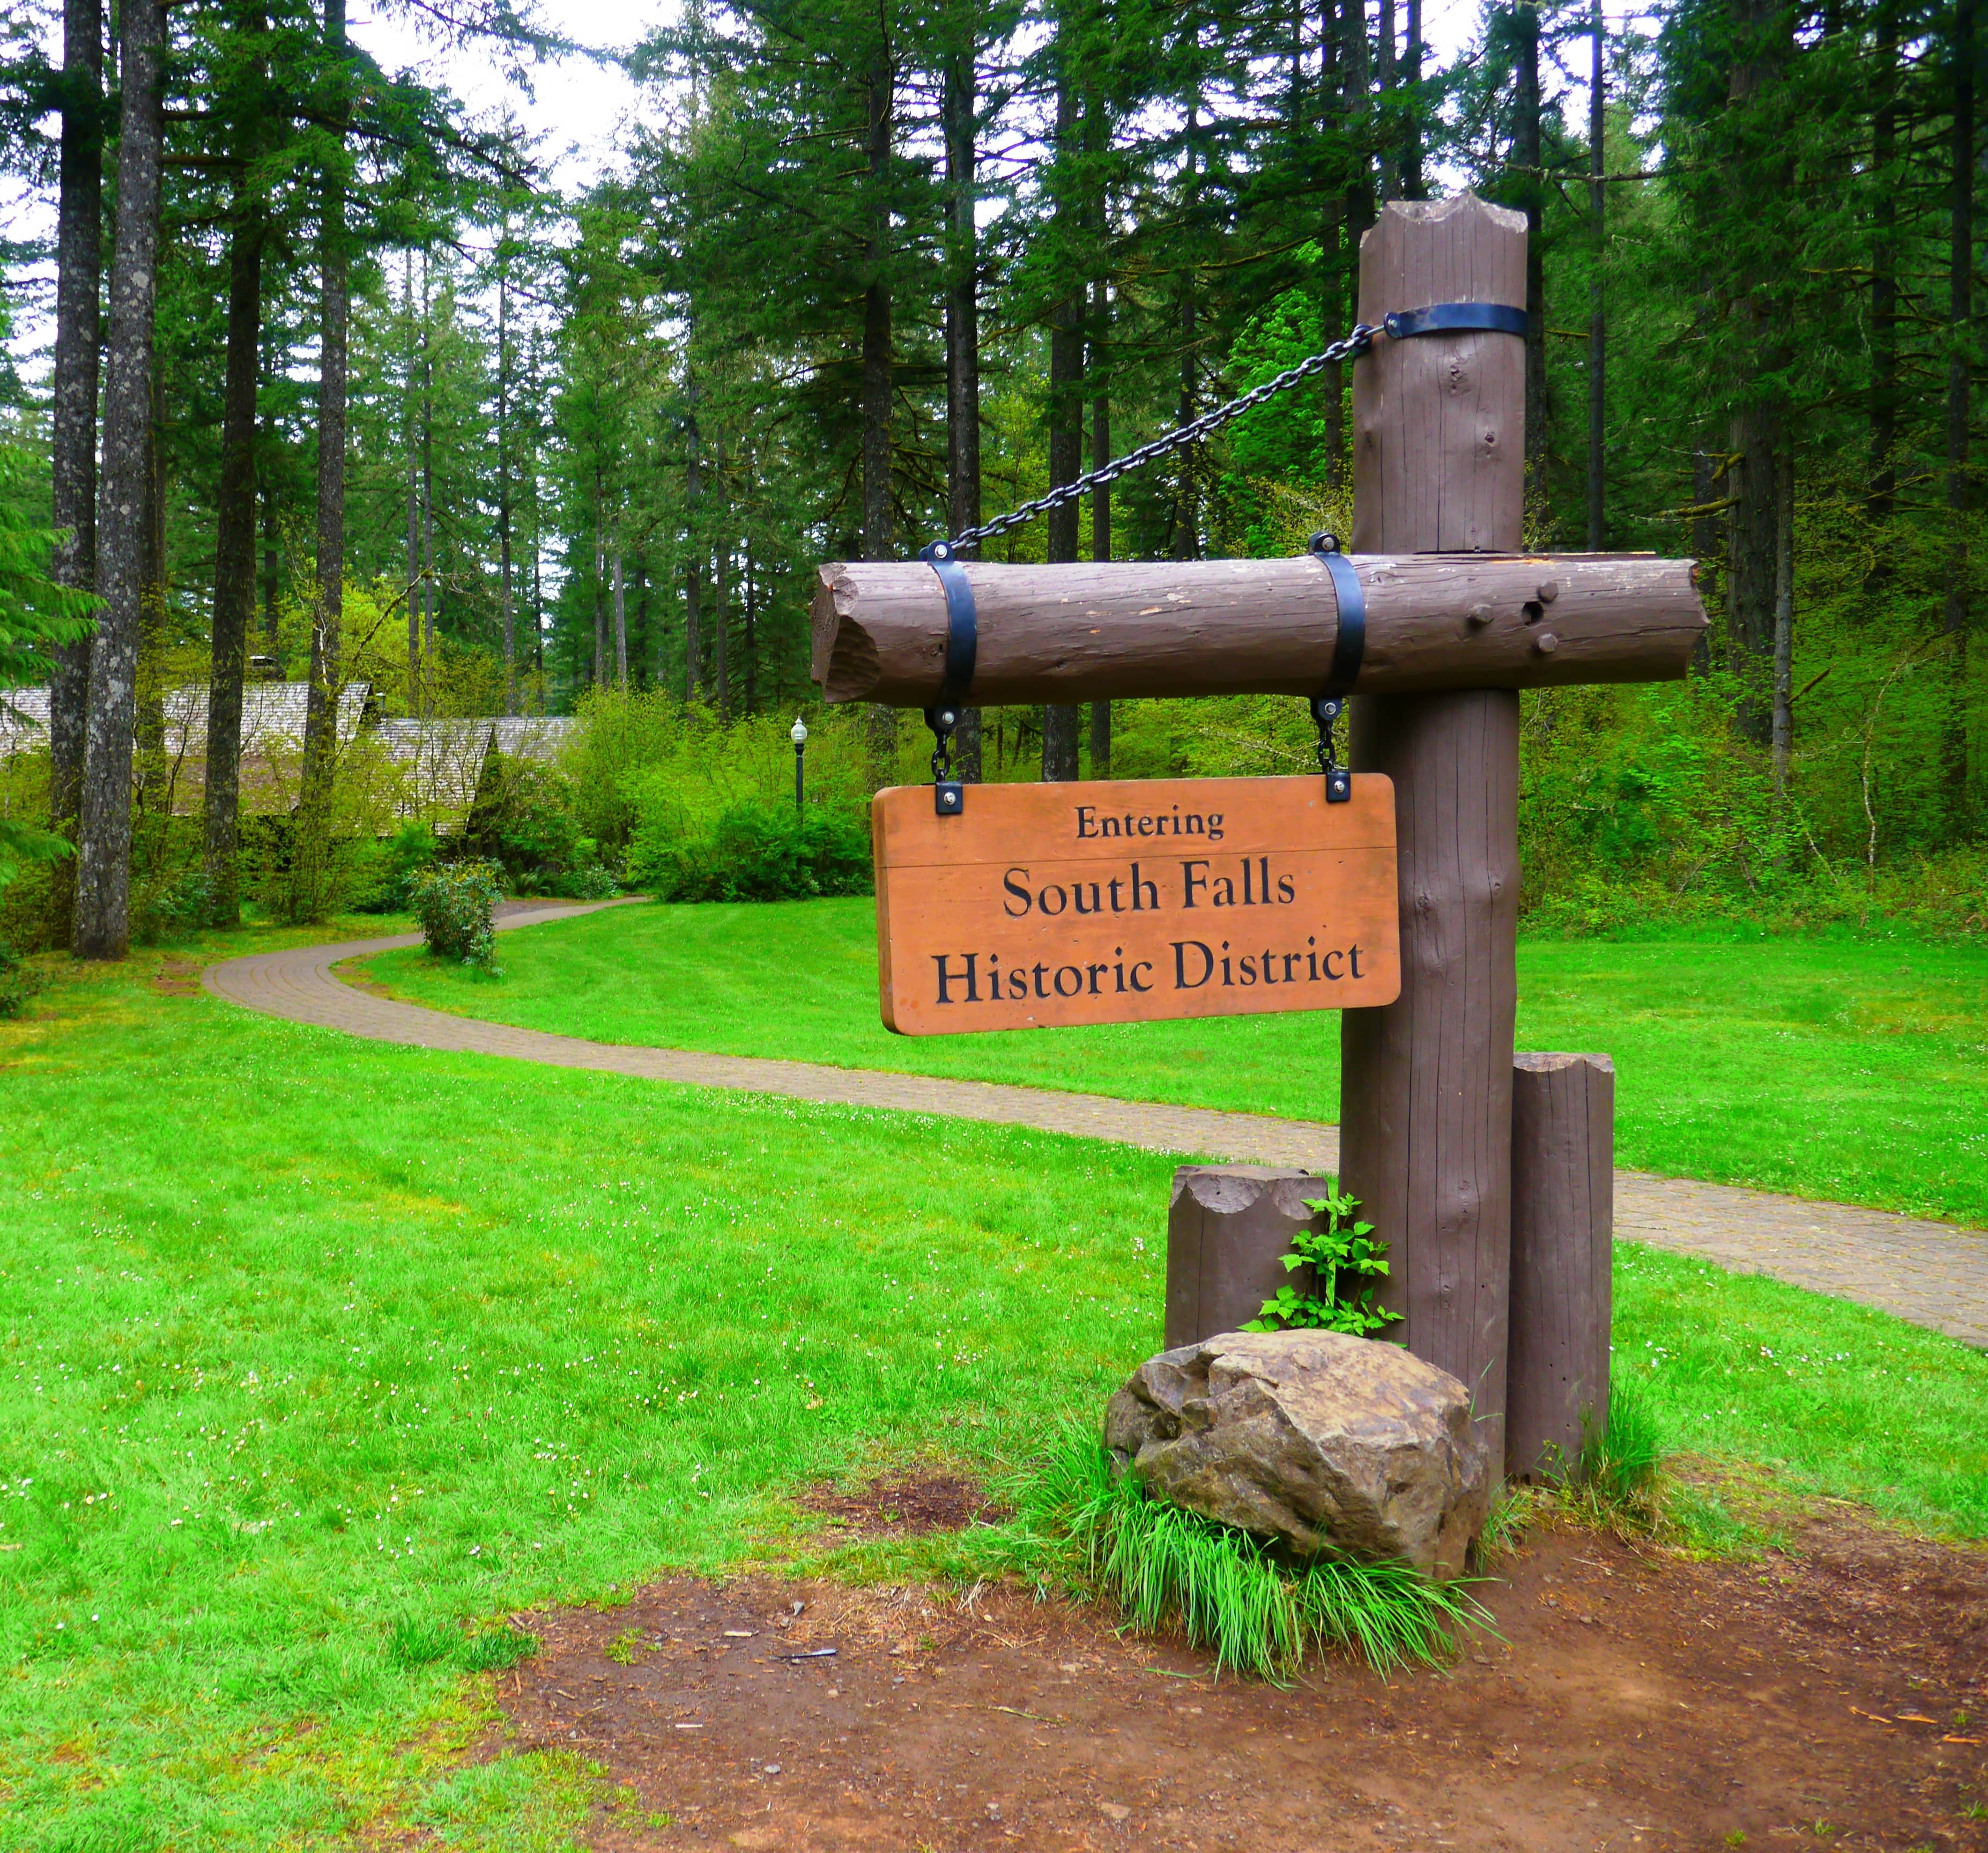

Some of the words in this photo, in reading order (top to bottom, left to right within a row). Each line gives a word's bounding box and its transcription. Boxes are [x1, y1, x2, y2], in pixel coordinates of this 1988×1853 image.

[1075, 805, 1225, 840] Entering
[1003, 861, 1161, 917] South
[1180, 856, 1295, 909] Falls
[931, 946, 1153, 1004] Historic
[1169, 936, 1366, 990] District
